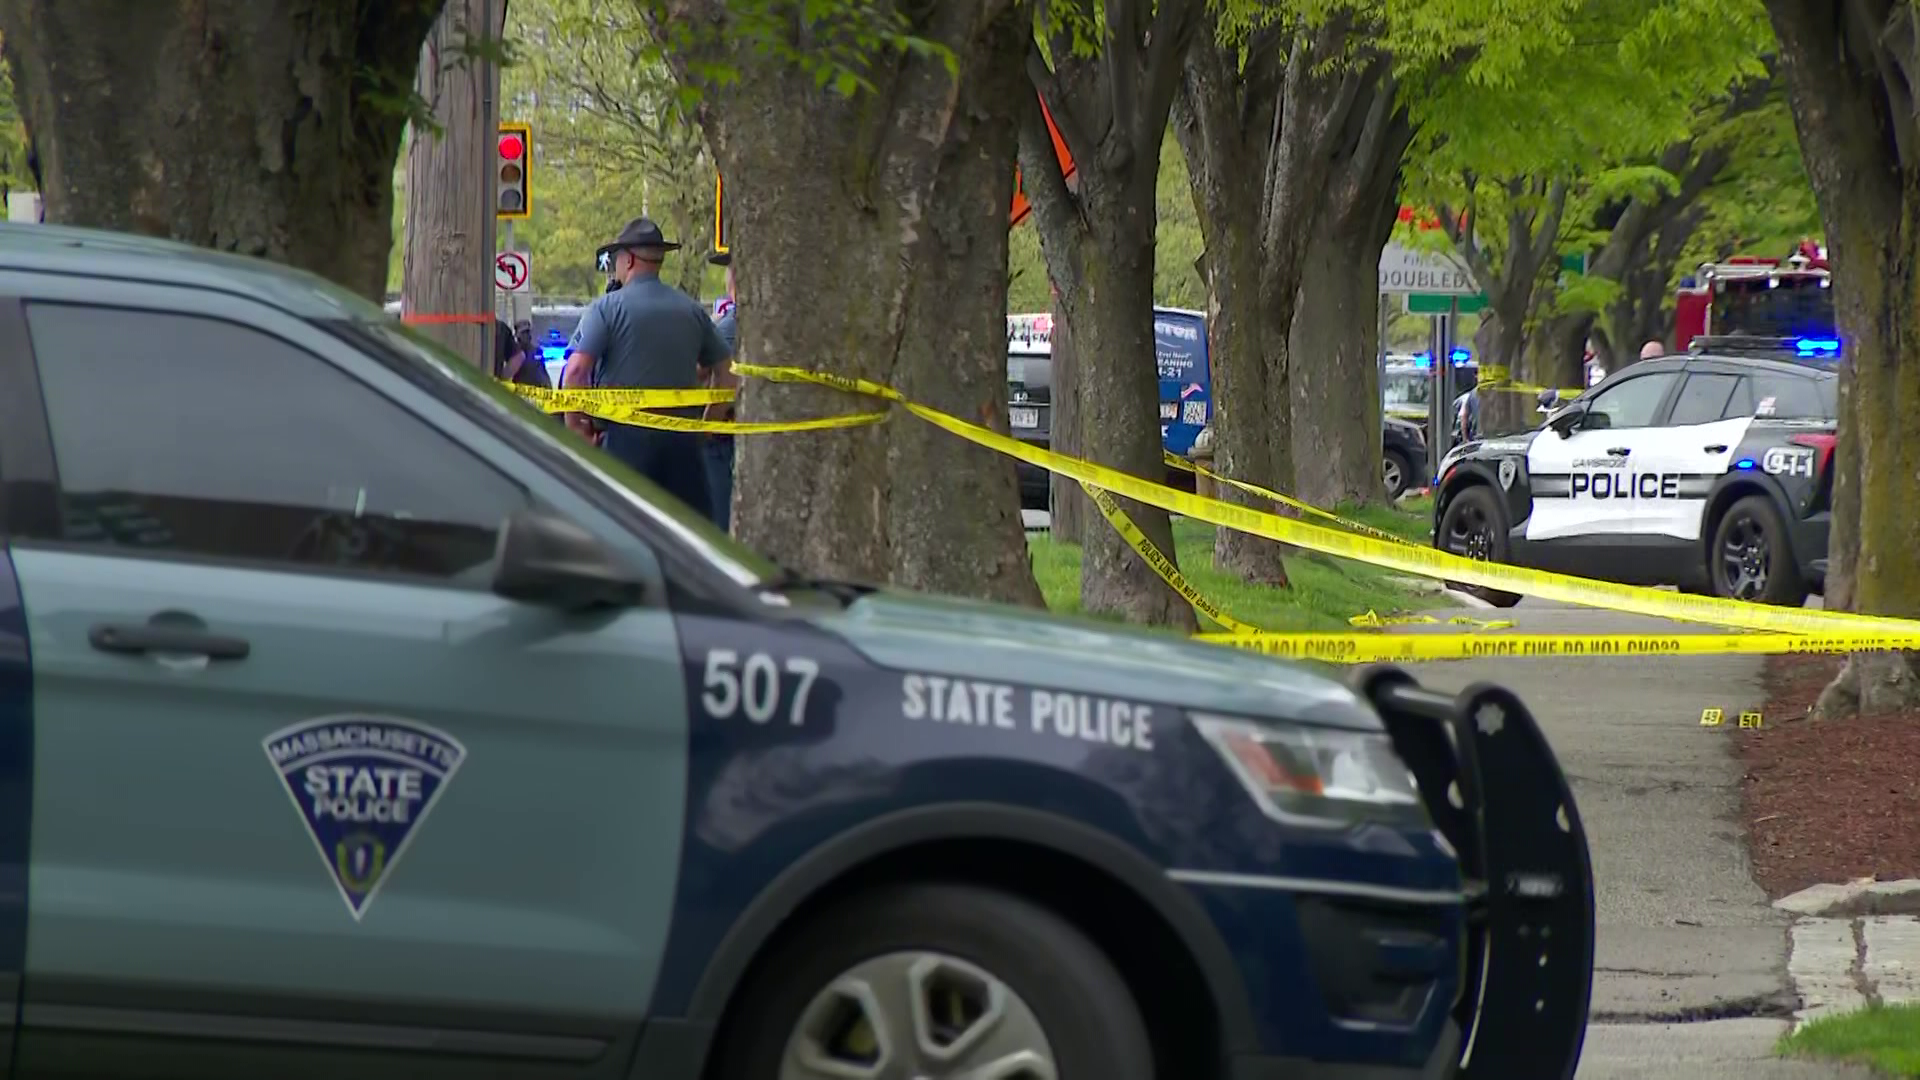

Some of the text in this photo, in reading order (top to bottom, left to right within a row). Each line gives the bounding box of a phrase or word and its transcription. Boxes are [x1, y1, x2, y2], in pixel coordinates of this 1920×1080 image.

[1571, 473, 1678, 500] POLICE
[1137, 538, 1163, 567] POLICE
[1158, 559, 1177, 581] LINE
[1183, 585, 1198, 601] NOT
[1195, 597, 1219, 619] CROSS
[702, 648, 819, 725] 507
[902, 673, 1154, 751] STATE POLICE
[272, 726, 461, 768] MASSACHUSETTS
[304, 765, 424, 800] STATE
[314, 797, 411, 822] POLICE
